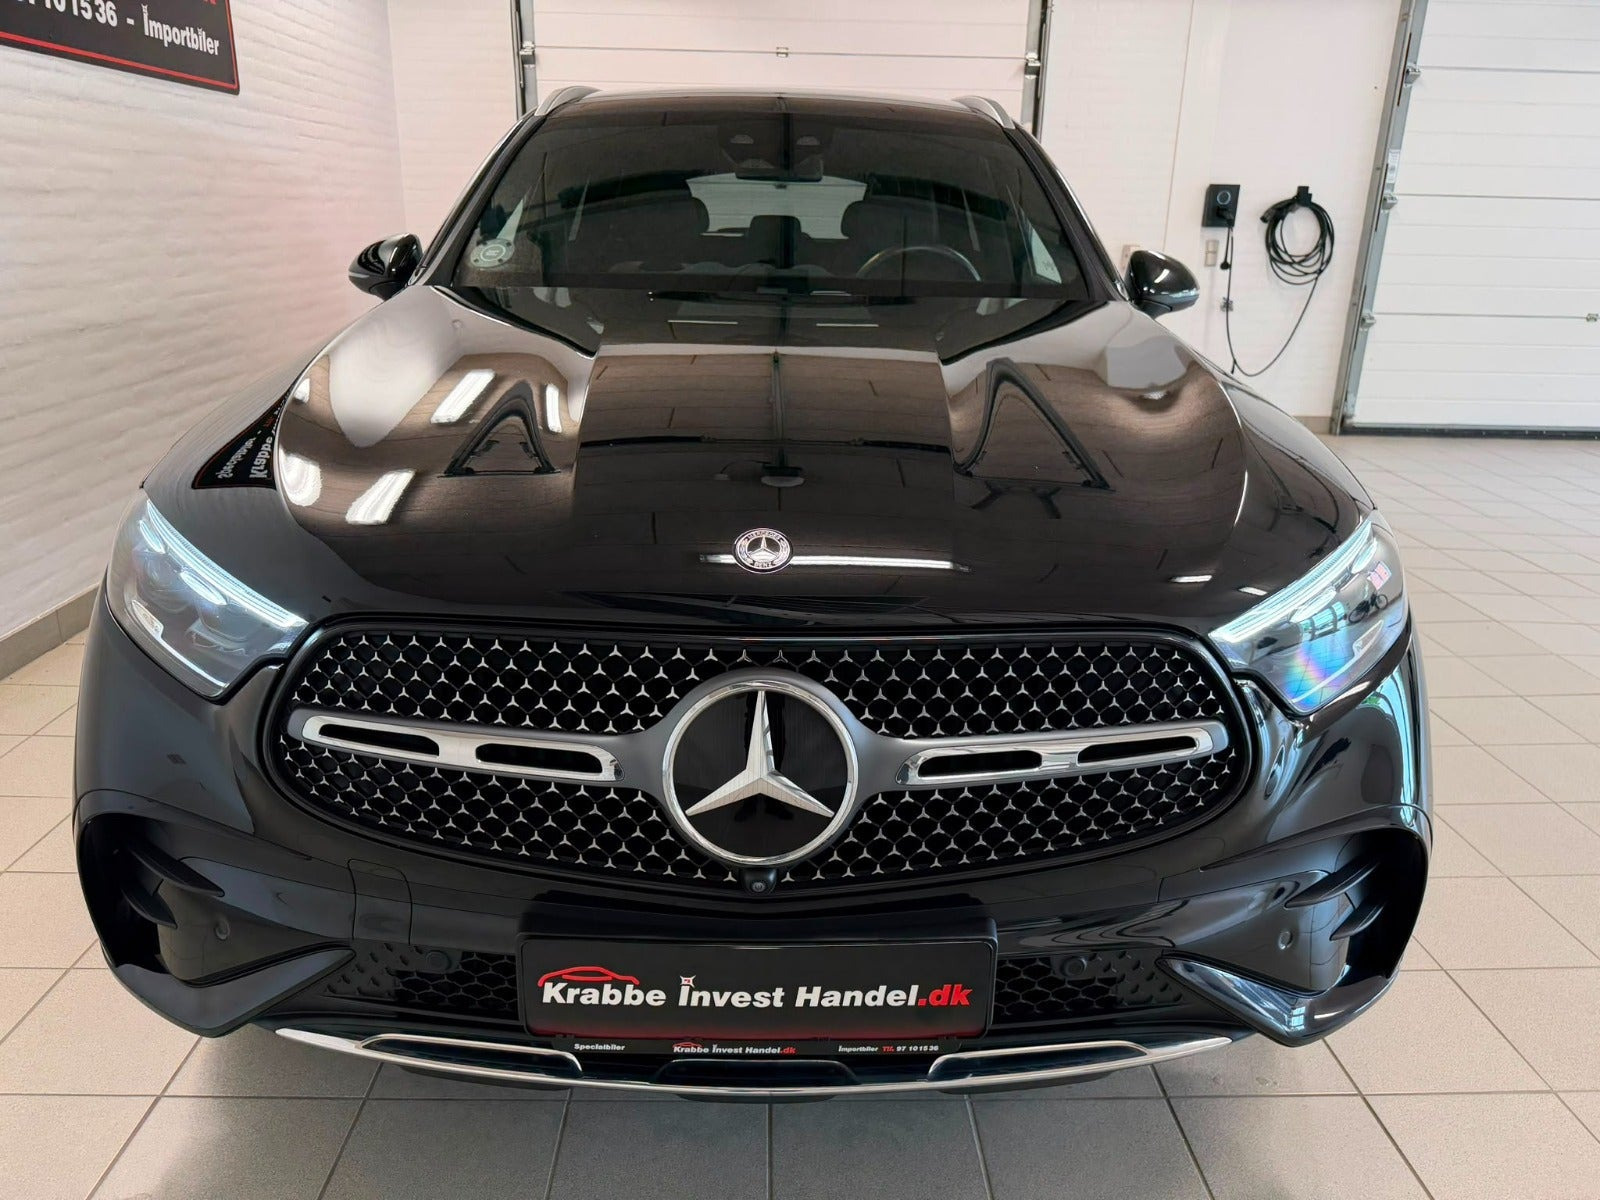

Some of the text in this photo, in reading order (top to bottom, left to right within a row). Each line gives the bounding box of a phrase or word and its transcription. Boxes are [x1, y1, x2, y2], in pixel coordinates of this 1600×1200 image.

[541, 975, 972, 1008] Krabbe Invest Handel.dk
[573, 1043, 625, 1051] Specialbiler
[673, 1044, 796, 1054] Krabbe Invest Handel.dk
